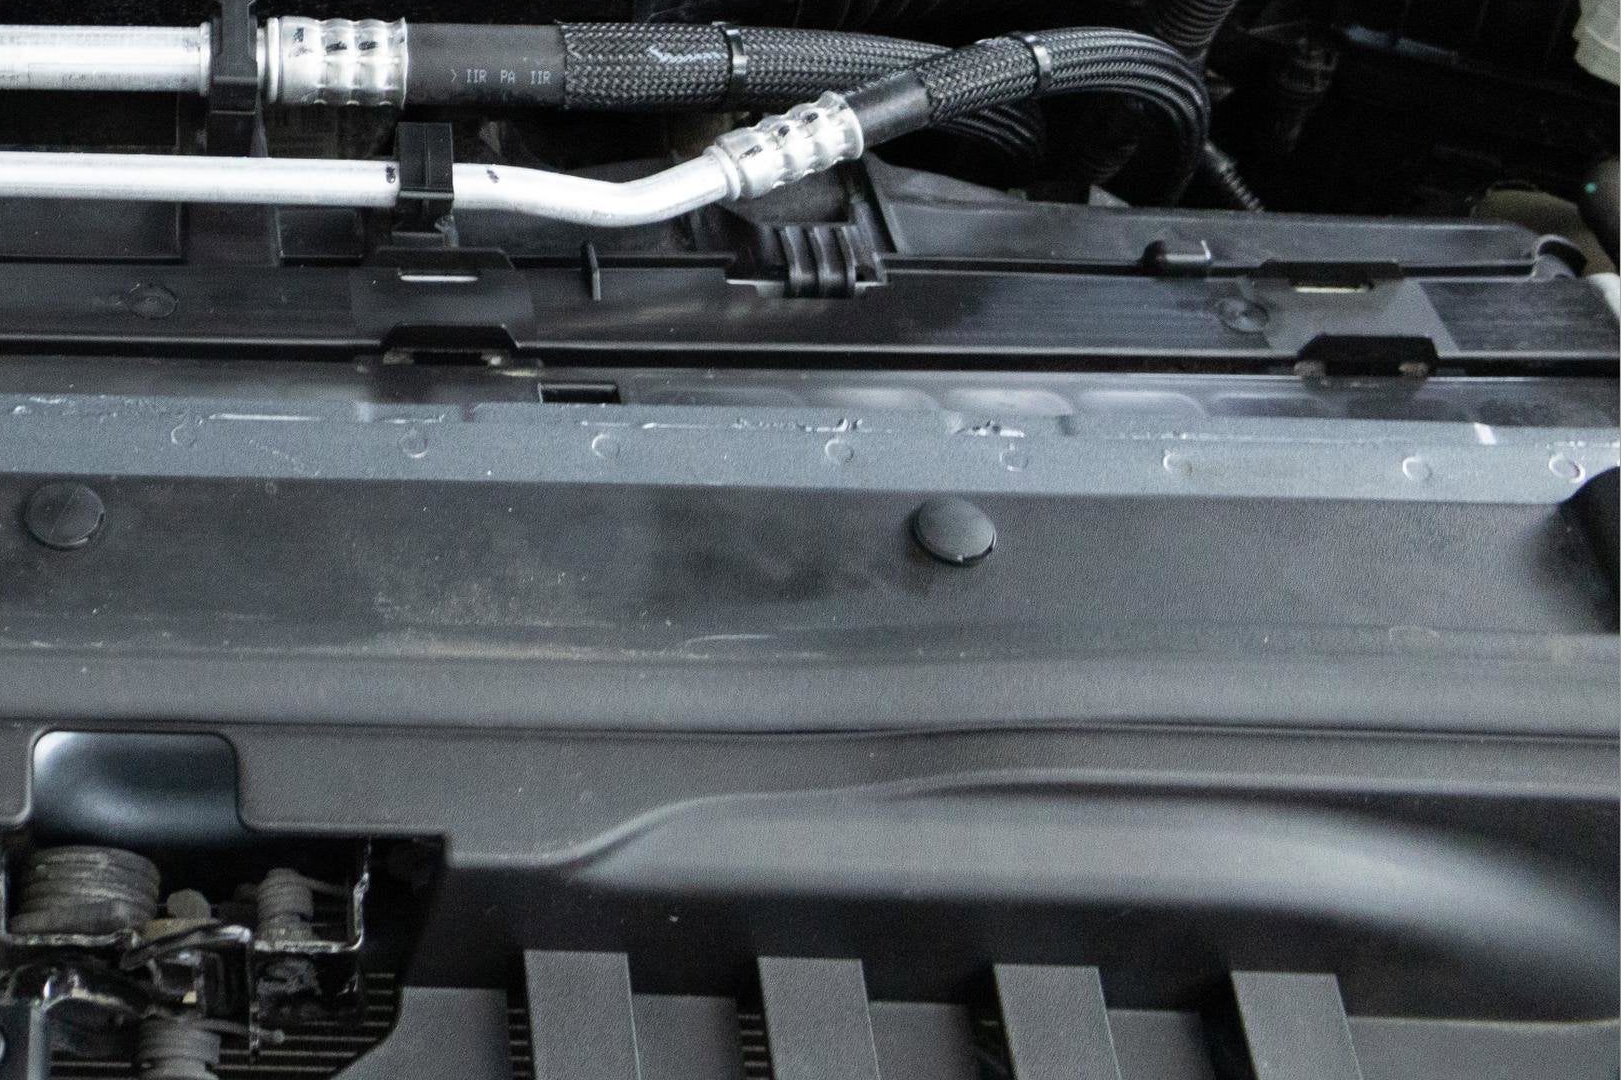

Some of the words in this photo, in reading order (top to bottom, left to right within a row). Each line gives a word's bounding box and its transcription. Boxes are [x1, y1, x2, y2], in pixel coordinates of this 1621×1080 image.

[466, 68, 487, 84] IIR
[500, 69, 516, 85] PA
[530, 70, 552, 86] IIR
